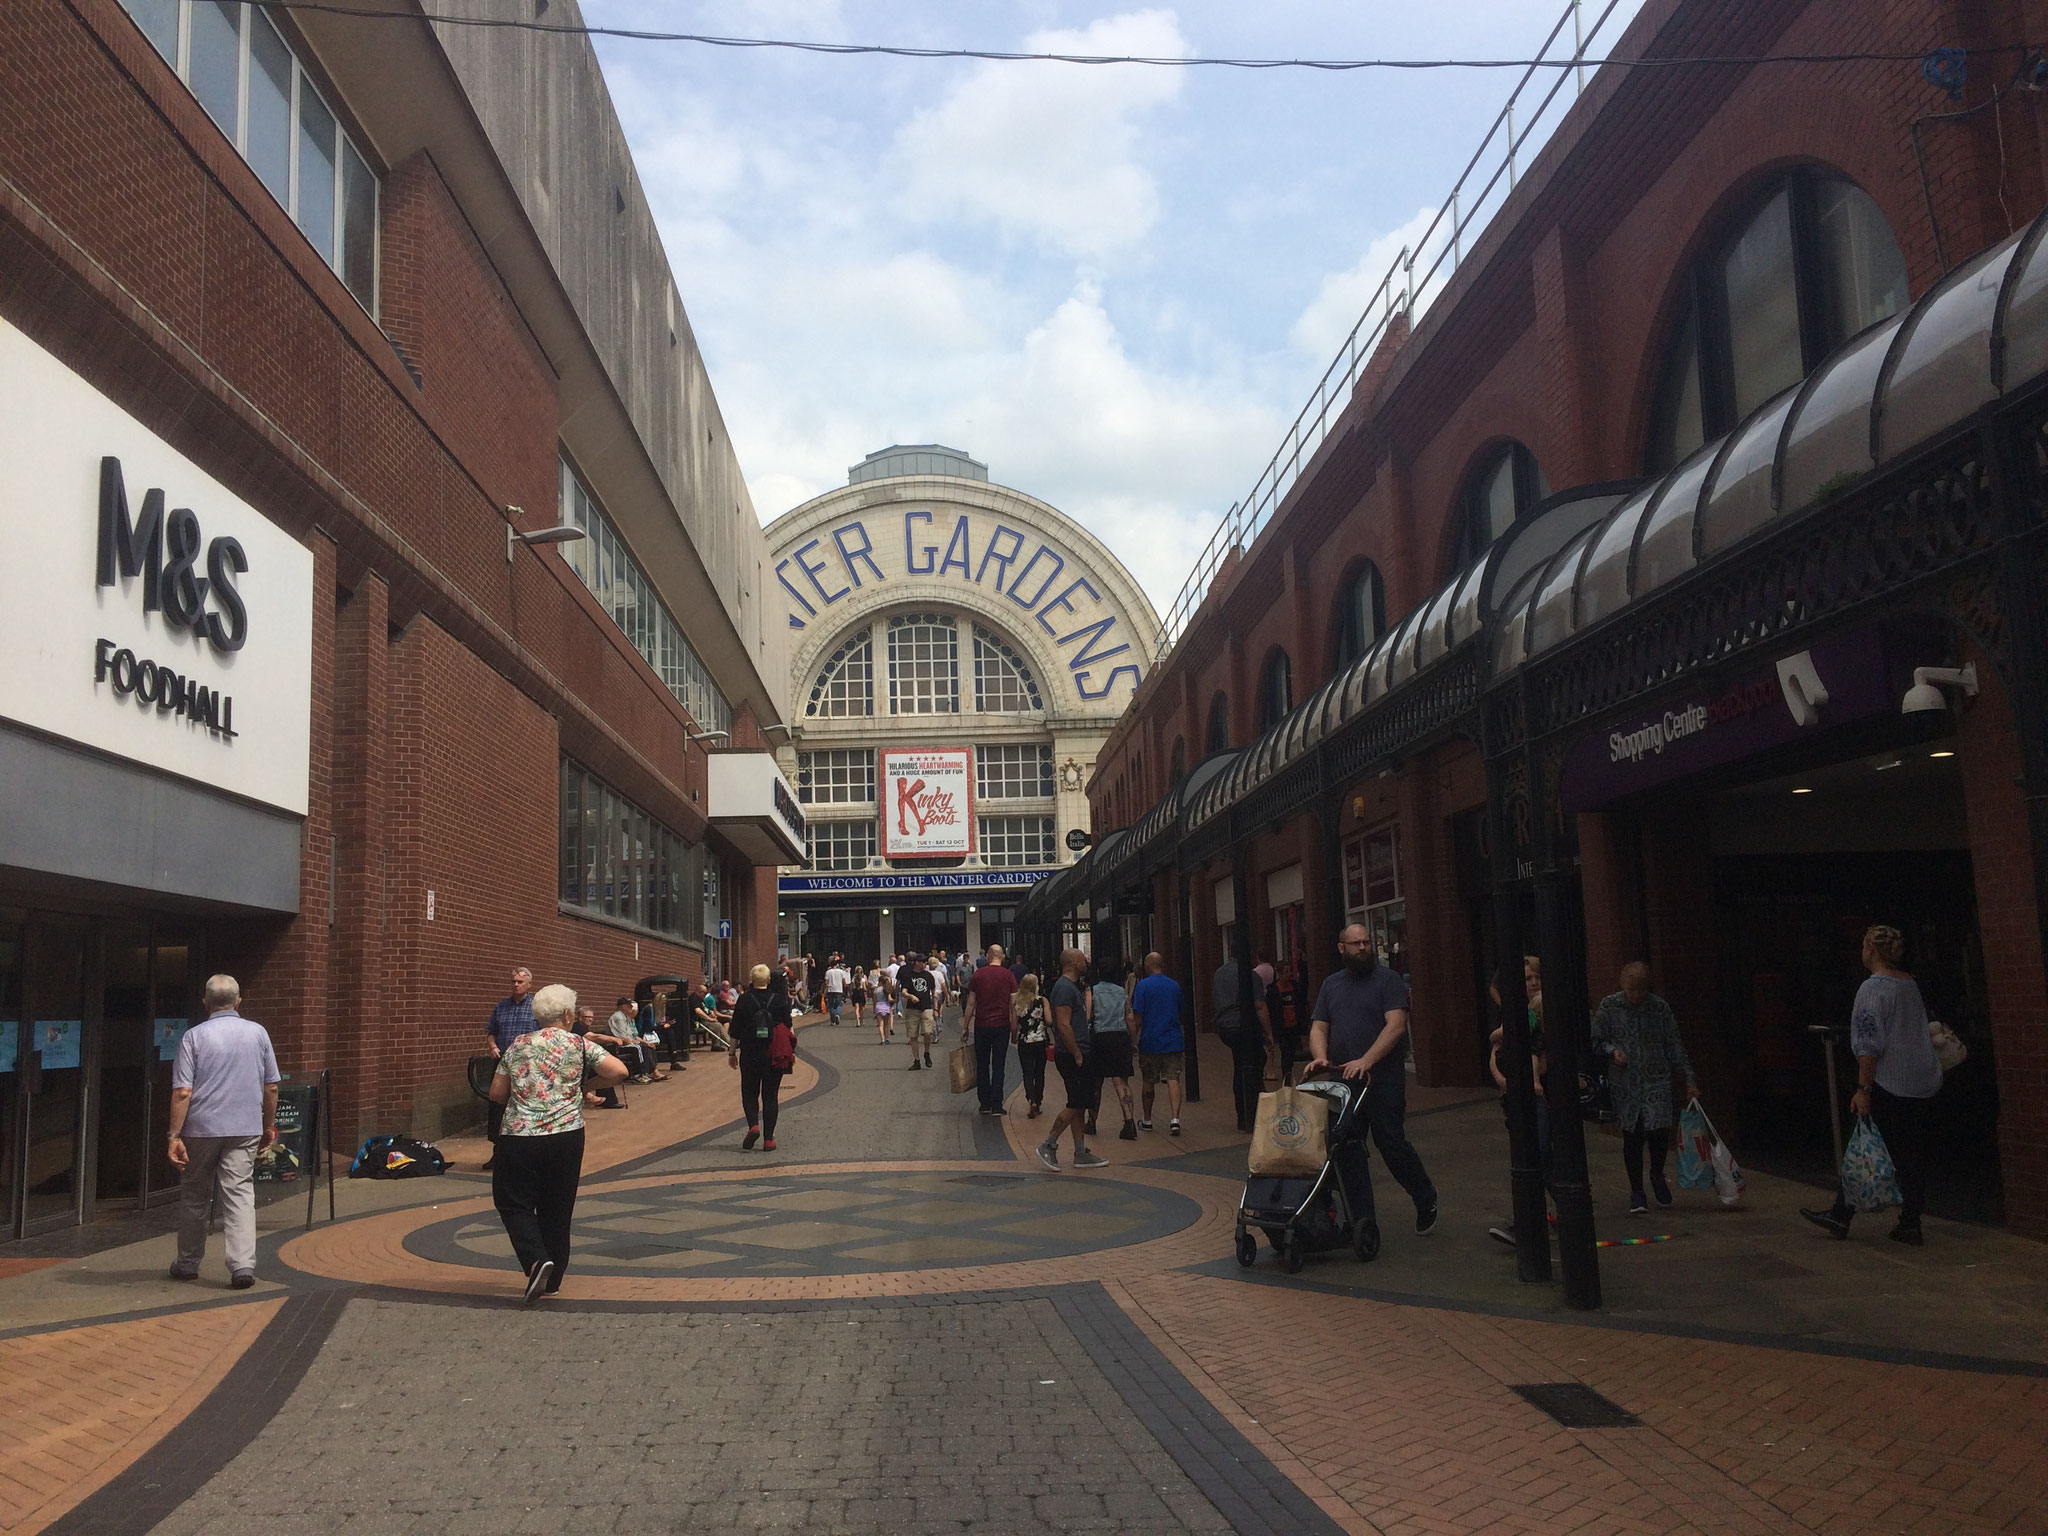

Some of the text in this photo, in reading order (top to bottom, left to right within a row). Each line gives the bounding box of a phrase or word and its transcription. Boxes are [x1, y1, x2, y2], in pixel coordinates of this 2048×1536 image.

[97, 456, 249, 652] M&S
[775, 511, 1142, 700] TER GARDENS
[95, 638, 239, 738] FOODHALL
[1609, 722, 1664, 762] Shopping
[1664, 703, 1708, 742] Centre
[919, 761, 963, 770] HEARTWARMING
[924, 809, 961, 825] Boots
[1069, 832, 1085, 840] Bella
[1069, 840, 1086, 848] Italia
[808, 872, 1050, 889] WELCOME TO THE WINTER GARDENS
[1278, 1115, 1300, 1136] 50
